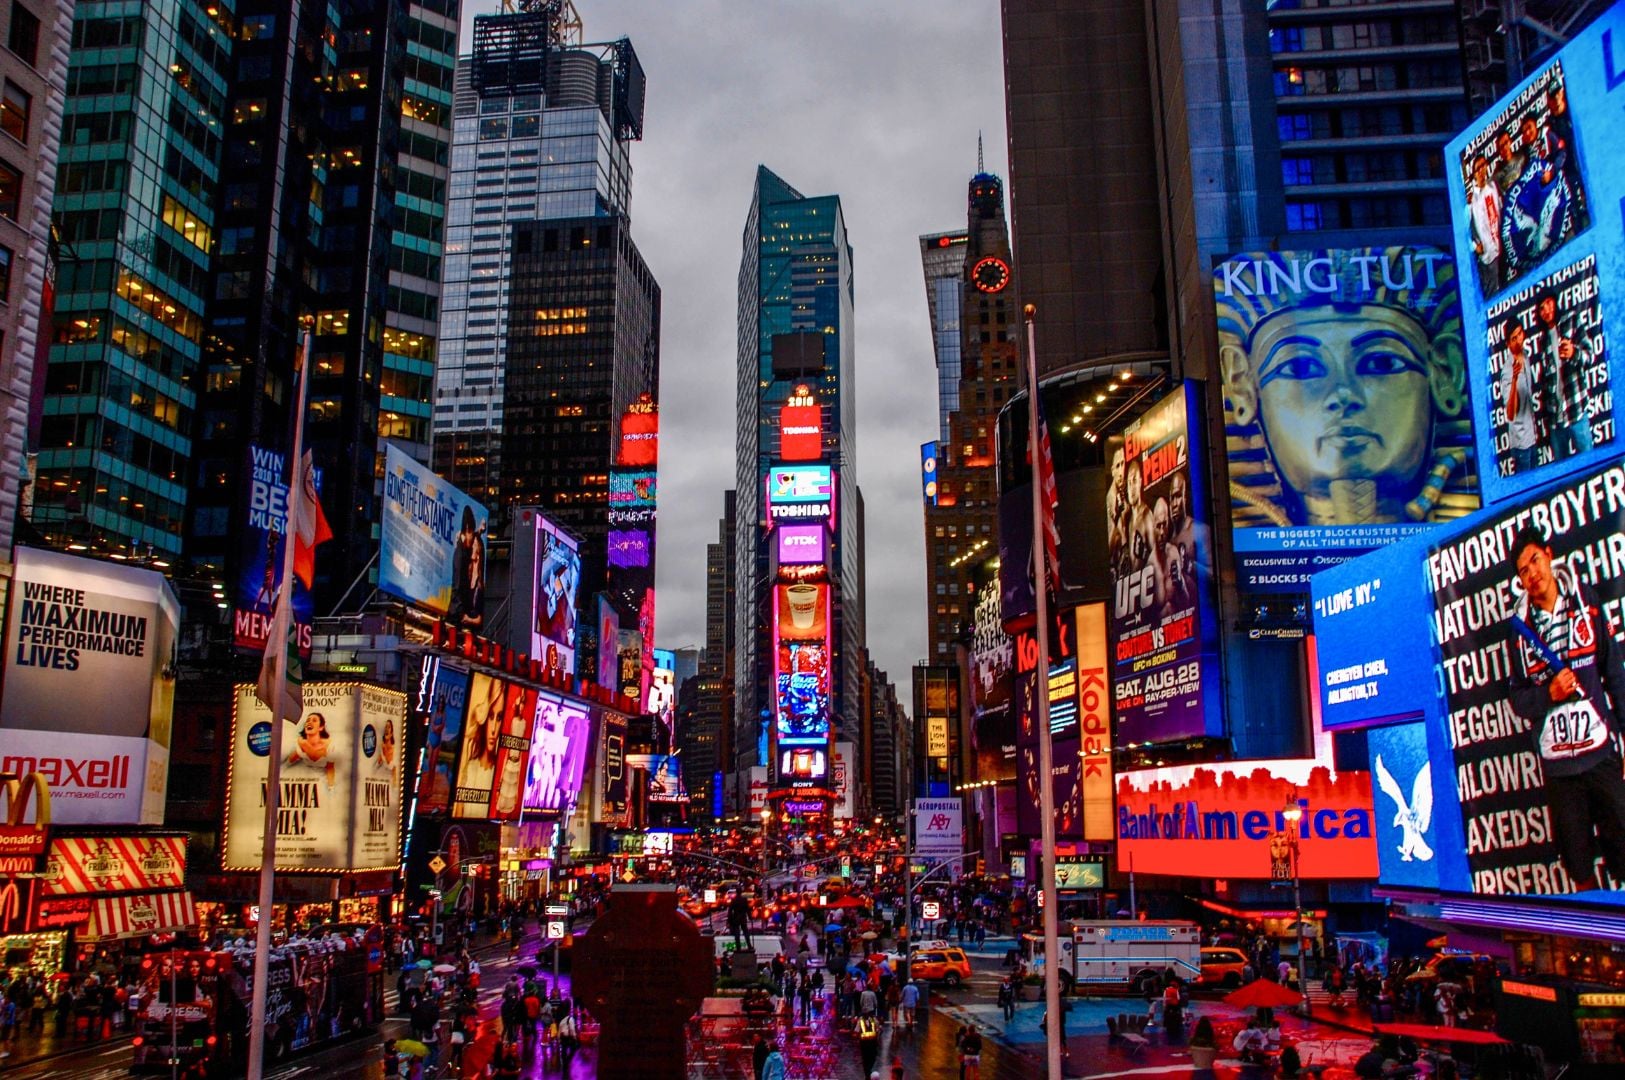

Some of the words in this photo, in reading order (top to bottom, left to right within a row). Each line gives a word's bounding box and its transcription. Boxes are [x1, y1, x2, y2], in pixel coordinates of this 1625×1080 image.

[1222, 257, 1338, 297] KING
[1349, 253, 1444, 292] TUT
[788, 396, 814, 407] 2010
[782, 426, 820, 435] TOSHIBA
[251, 445, 285, 472] WIN
[1143, 439, 1177, 486] PENN
[1177, 434, 1187, 465] 2
[252, 466, 273, 483] 2010
[404, 481, 419, 519] THE
[418, 491, 456, 546] DISTANCE
[770, 504, 830, 517] TOSHIBA
[791, 536, 818, 545] TDK
[1256, 530, 1277, 539] THE
[1279, 529, 1322, 539] BIGGEST
[1325, 527, 1398, 537] BLOCKBUSTER
[1282, 539, 1295, 548] OF
[1298, 538, 1318, 547] ALL
[1321, 538, 1346, 547] TIME
[1349, 537, 1398, 546] RETURNS
[1244, 557, 1296, 567] EXCLUSIVELY
[1298, 556, 1308, 566] AT
[1249, 575, 1257, 584] 2
[1258, 574, 1298, 583] BLOCKS
[24, 581, 84, 607] WHERE
[1115, 565, 1155, 620] UFC
[1328, 587, 1354, 617] LOVE
[21, 600, 147, 642] MAXIMUM
[18, 624, 145, 657] PERFORMANCE
[1152, 626, 1165, 650] VS
[16, 642, 81, 672] LIVES
[1133, 661, 1146, 673] UFC
[1152, 650, 1177, 667] BOXING
[317, 687, 354, 697] MUSICAL
[1116, 679, 1142, 700] SAT.
[1116, 698, 1131, 710] LIVE
[1145, 681, 1200, 704] PAY-PER-VIEW
[1081, 667, 1108, 778] Kodak
[1550, 711, 1591, 744] 1972
[930, 731, 945, 741] LION
[930, 742, 946, 750] KING
[2, 755, 130, 789] maxell
[363, 782, 390, 807] MAMMA
[368, 807, 385, 832] MIA!
[1119, 802, 1161, 839] Bank
[1161, 801, 1184, 839] of
[1183, 798, 1372, 840] America
